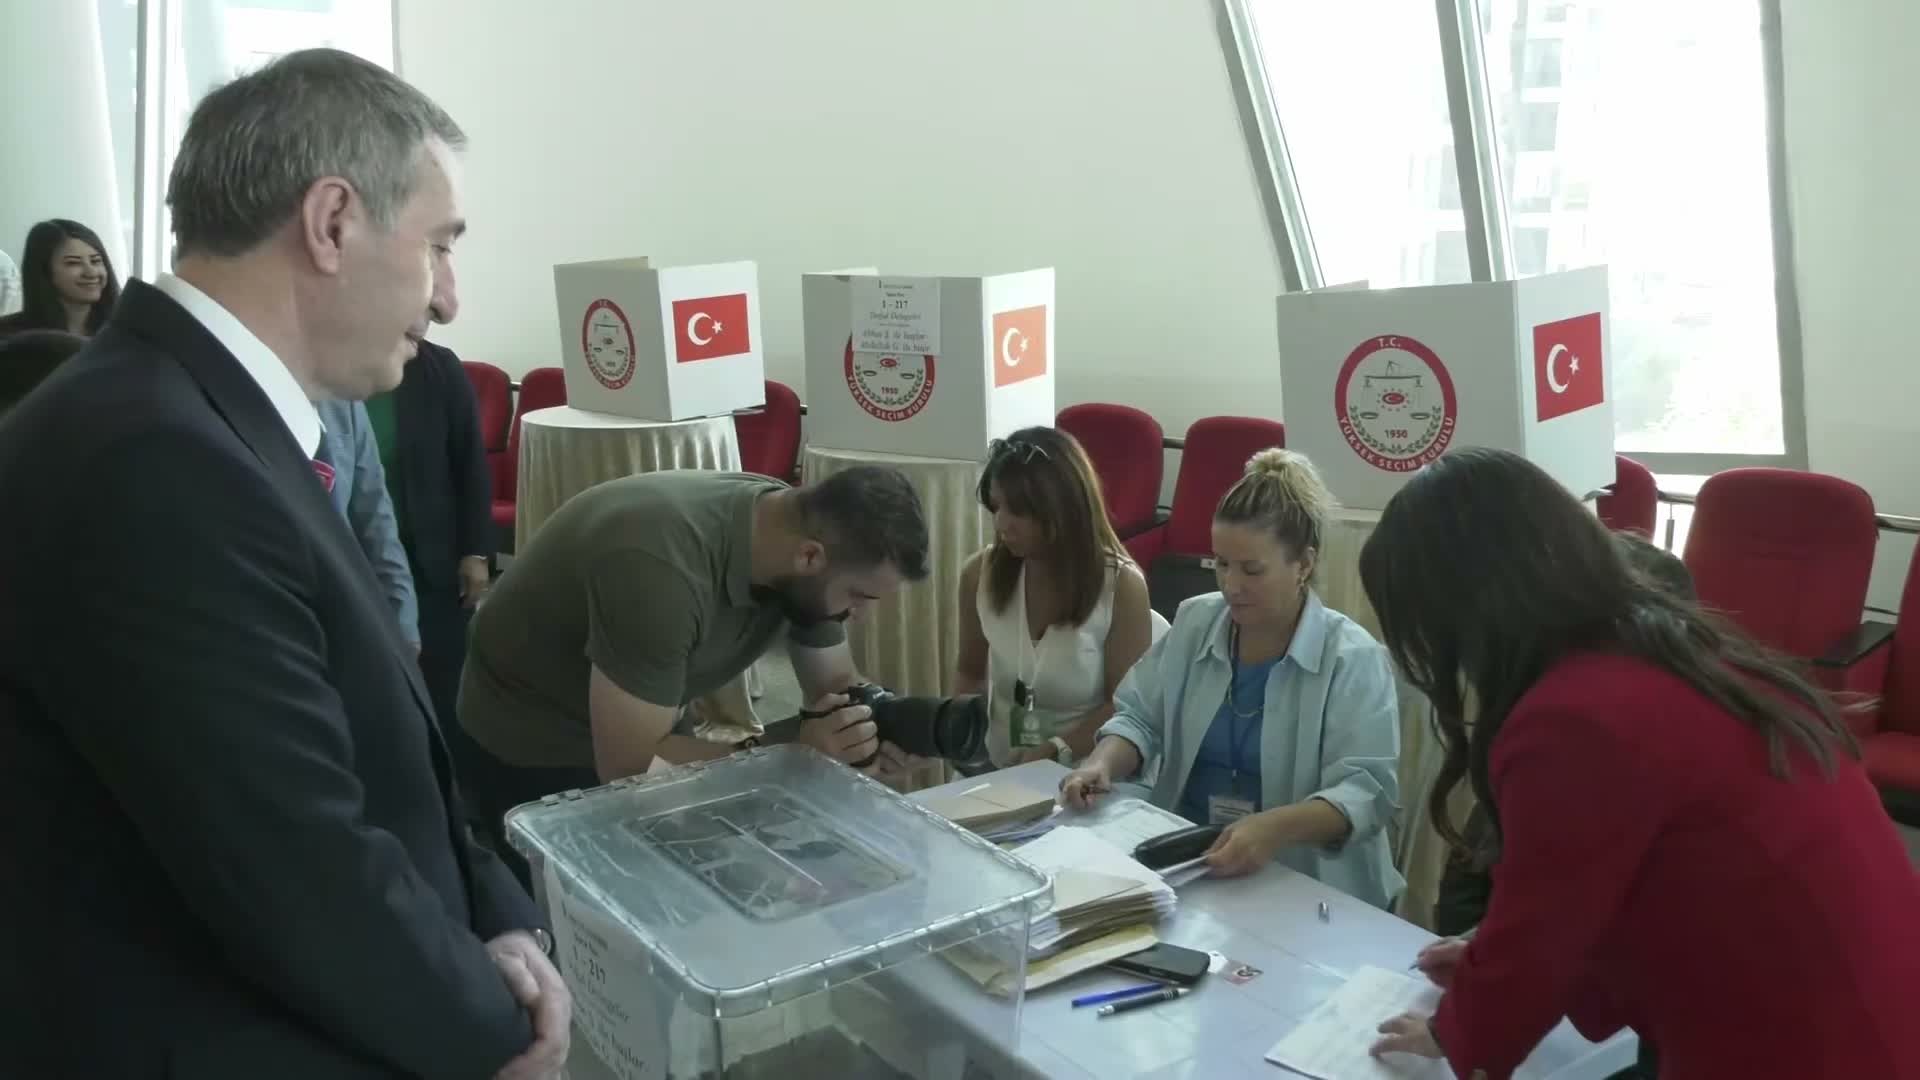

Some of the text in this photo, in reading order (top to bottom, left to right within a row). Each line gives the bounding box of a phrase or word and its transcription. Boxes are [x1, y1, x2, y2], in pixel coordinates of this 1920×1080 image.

[895, 300, 908, 309] 217
[1378, 336, 1401, 347] T.C.
[848, 376, 874, 413] YÜKSEK
[1384, 428, 1409, 440] 1950
[1340, 416, 1454, 472] YÜKSEK SEÇİM KURULU
[589, 959, 606, 985] 217
